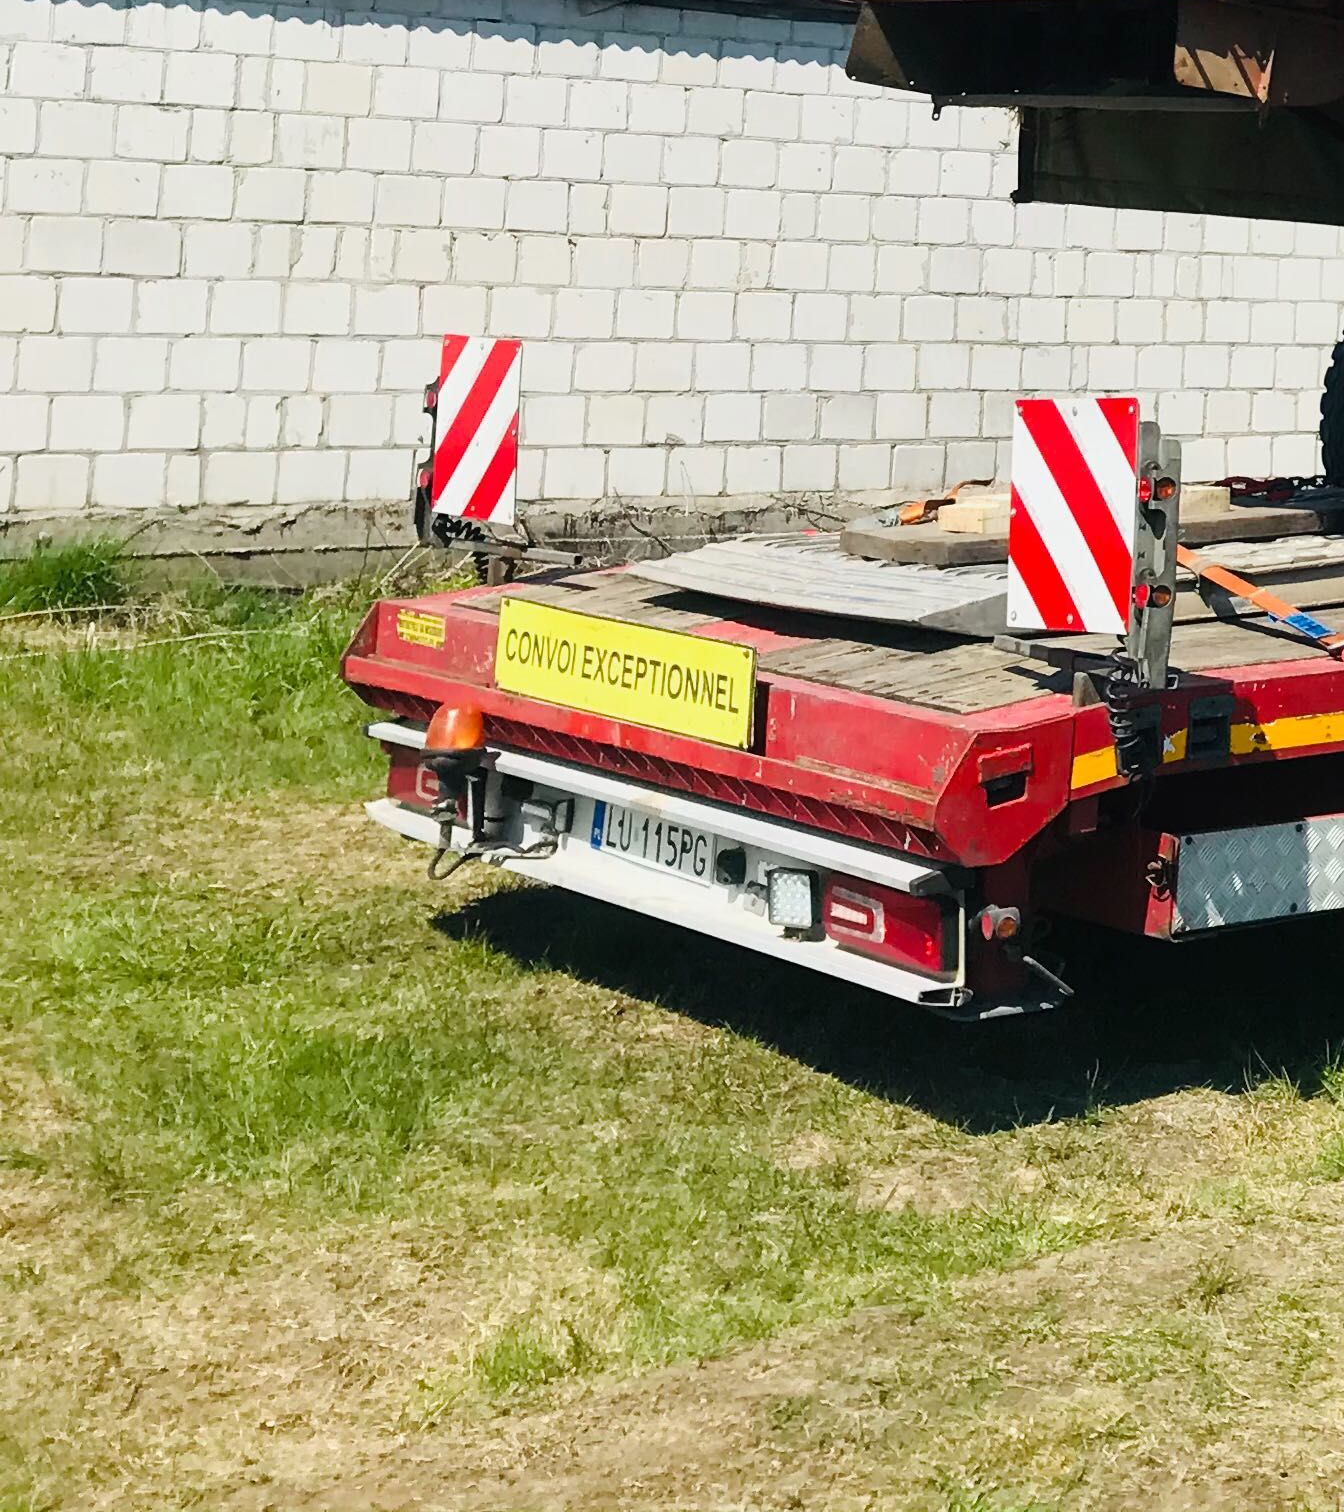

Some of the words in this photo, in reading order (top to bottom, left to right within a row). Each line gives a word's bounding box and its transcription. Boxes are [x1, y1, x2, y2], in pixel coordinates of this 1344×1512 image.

[505, 628, 578, 676] CONVOI
[580, 644, 740, 714] EXCEPTIONNEL
[605, 805, 633, 852] LU
[641, 817, 708, 877] 115PG
